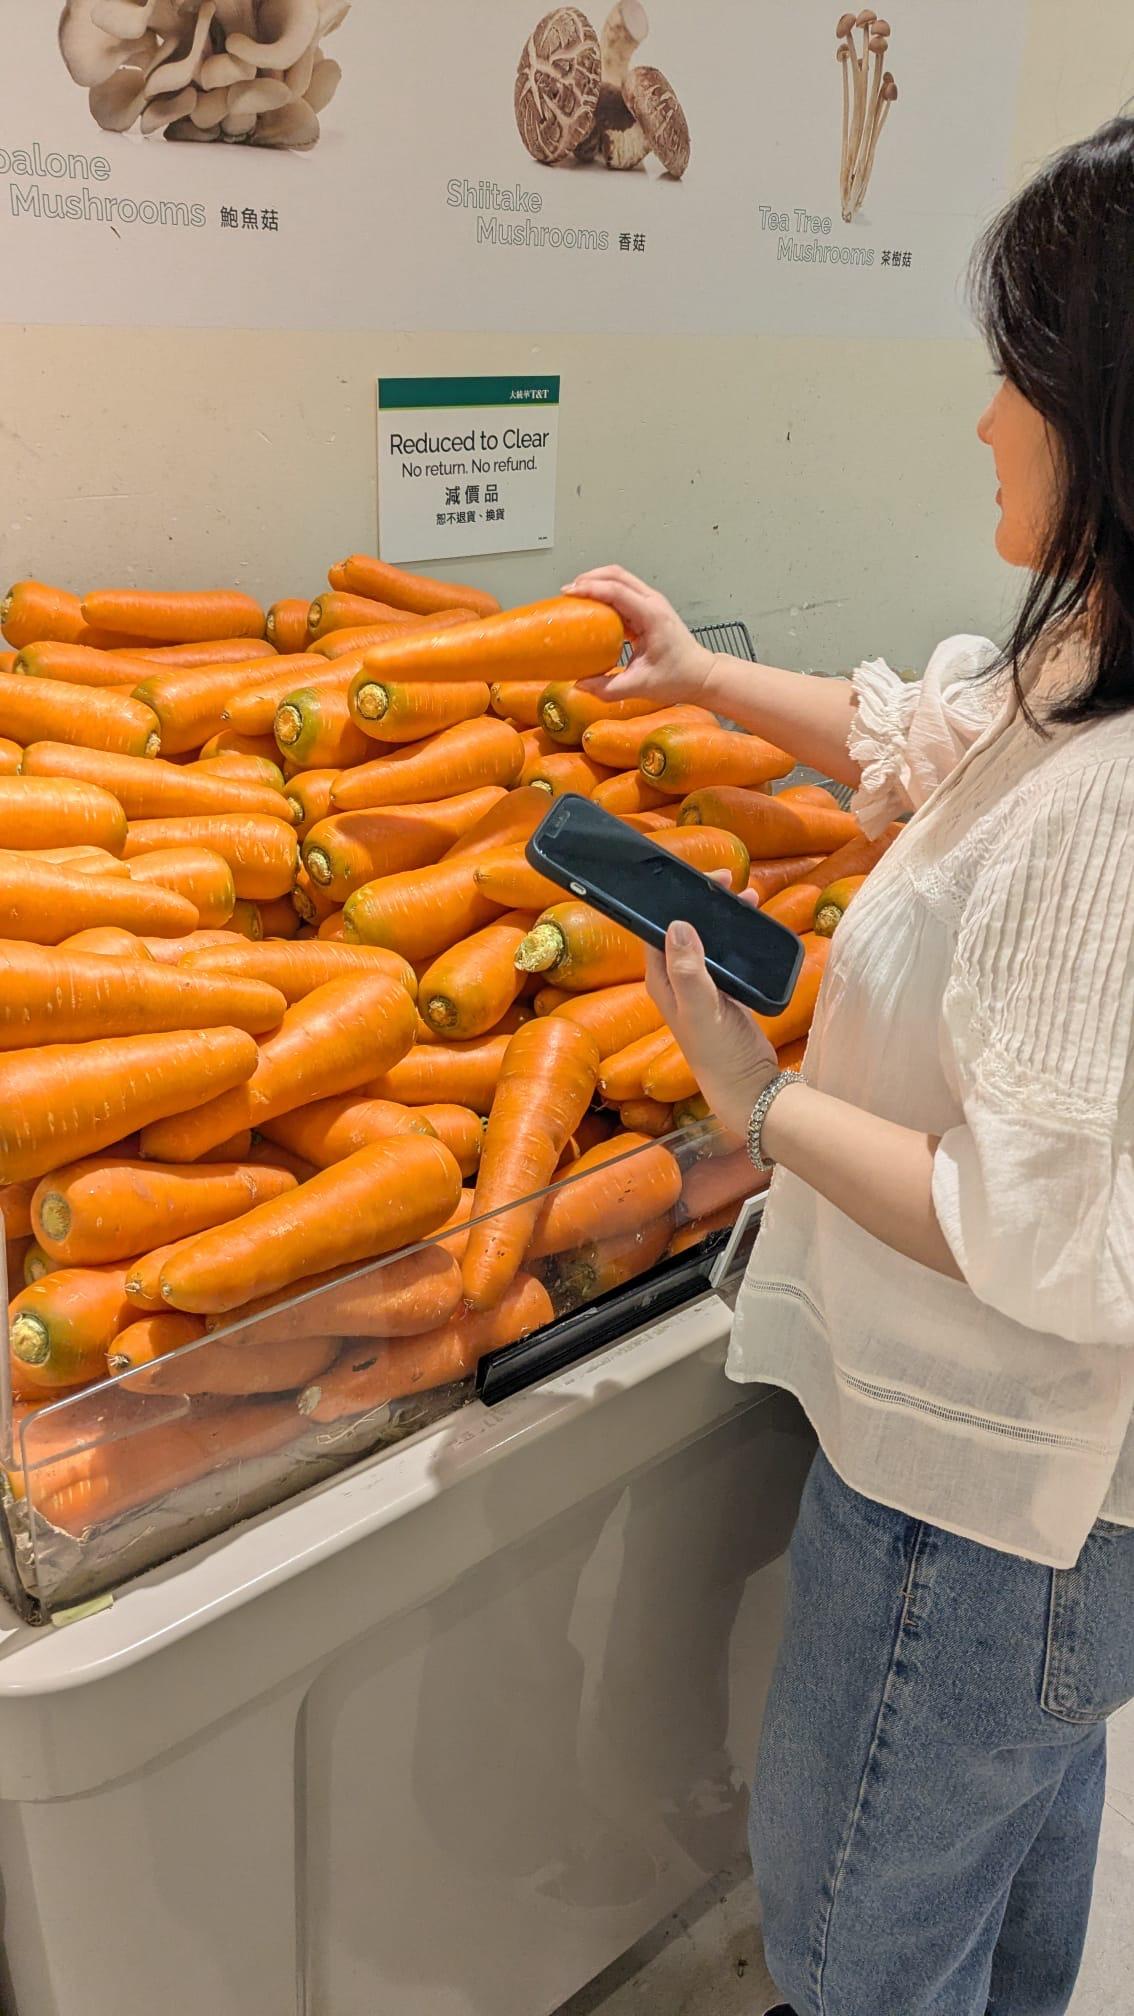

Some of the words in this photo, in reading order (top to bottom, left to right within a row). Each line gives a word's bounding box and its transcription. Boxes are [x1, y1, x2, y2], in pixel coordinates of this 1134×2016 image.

[9, 183, 206, 227] Mushrooms
[219, 206, 279, 231] 鮑魚菇
[446, 178, 543, 213] Shiitake
[476, 216, 609, 251] Mushrooms
[618, 232, 646, 252] 香菇
[758, 205, 790, 232] Tea
[794, 208, 833, 235] Tree
[776, 236, 875, 266] Mushrooms
[880, 250, 913, 268] 茶樹菇
[389, 430, 476, 456] Reduced
[480, 430, 499, 451] to
[502, 428, 550, 450] Clear
[401, 462, 422, 479] No
[425, 461, 469, 477] return.
[471, 458, 491, 474] No
[493, 456, 538, 473] refund.
[445, 484, 499, 506] 減價品
